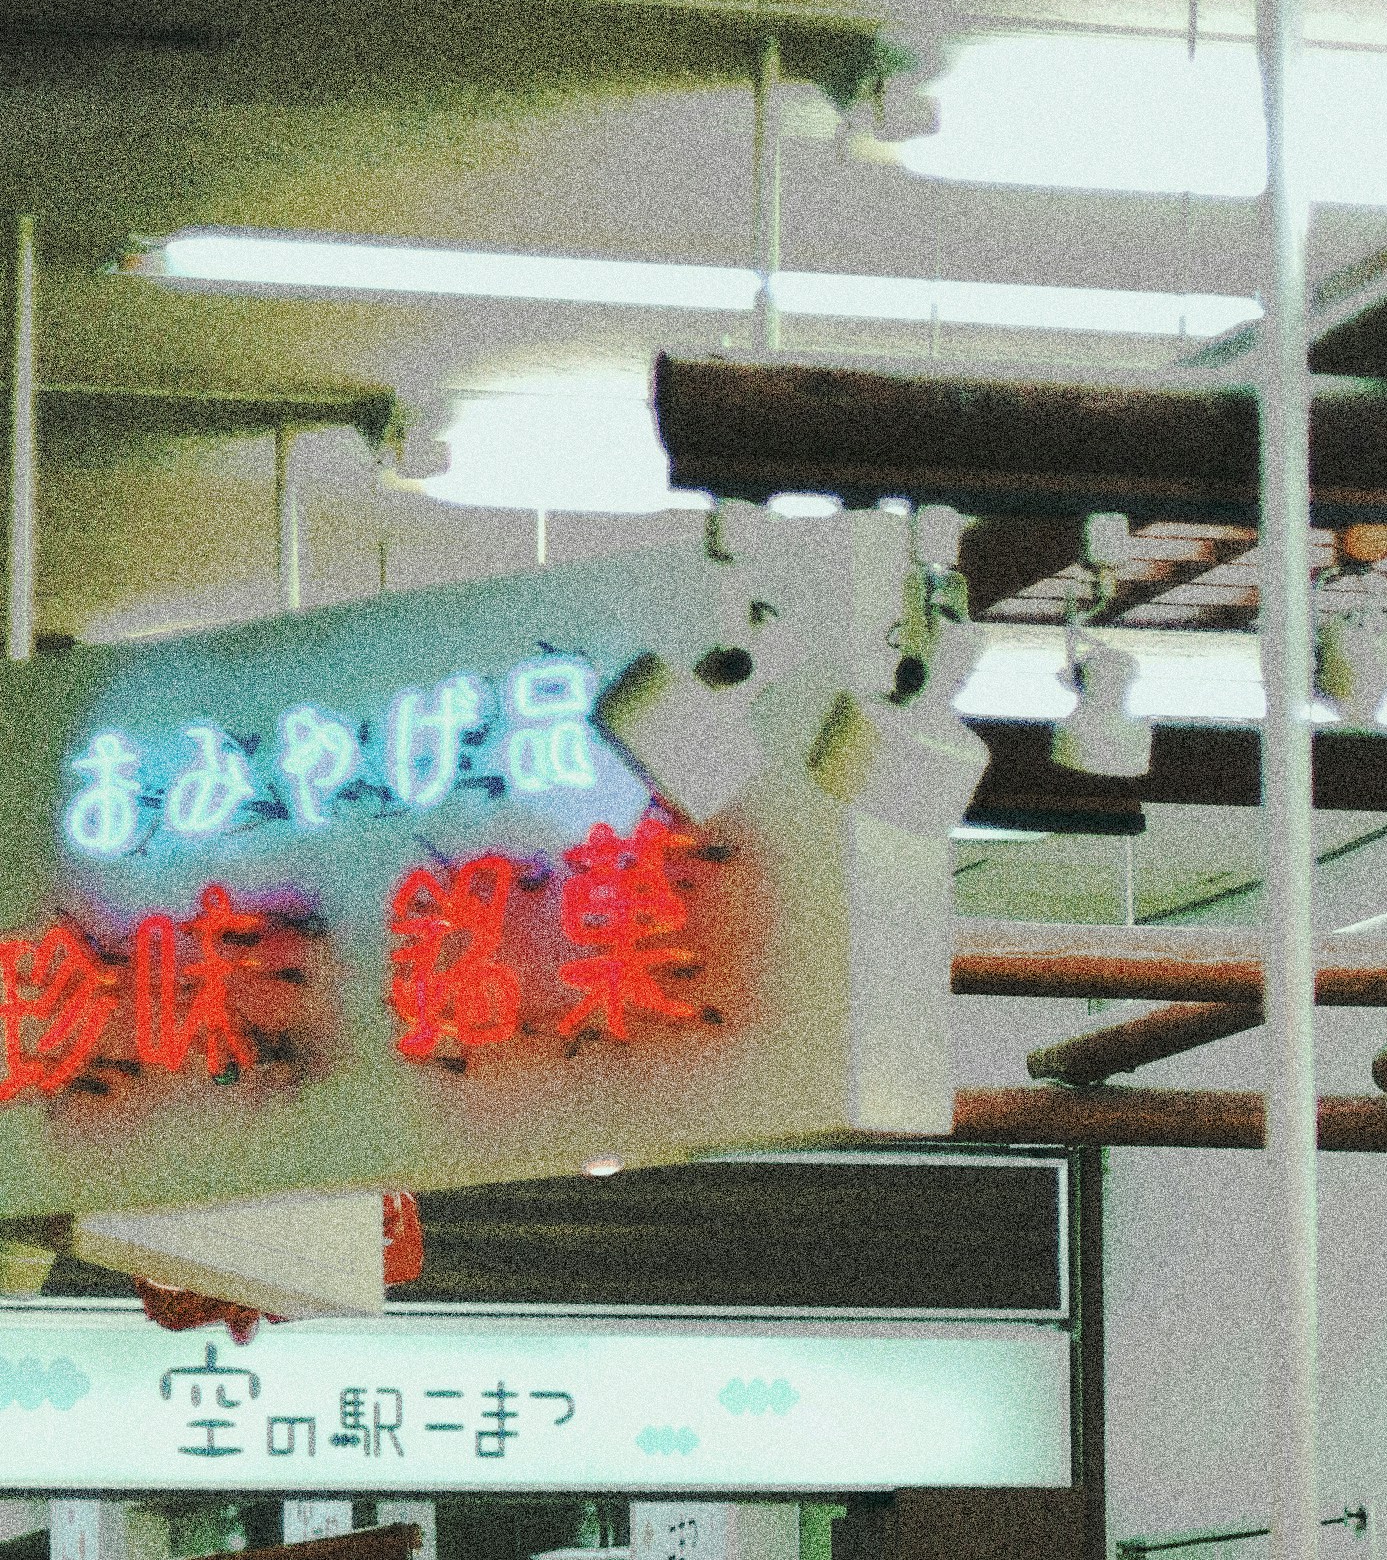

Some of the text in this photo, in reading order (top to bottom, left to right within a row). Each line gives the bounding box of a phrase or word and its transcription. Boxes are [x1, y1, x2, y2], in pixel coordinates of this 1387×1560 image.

[67, 653, 597, 856] おみやげ品
[160, 1343, 575, 1459] 空の駅こまつ
